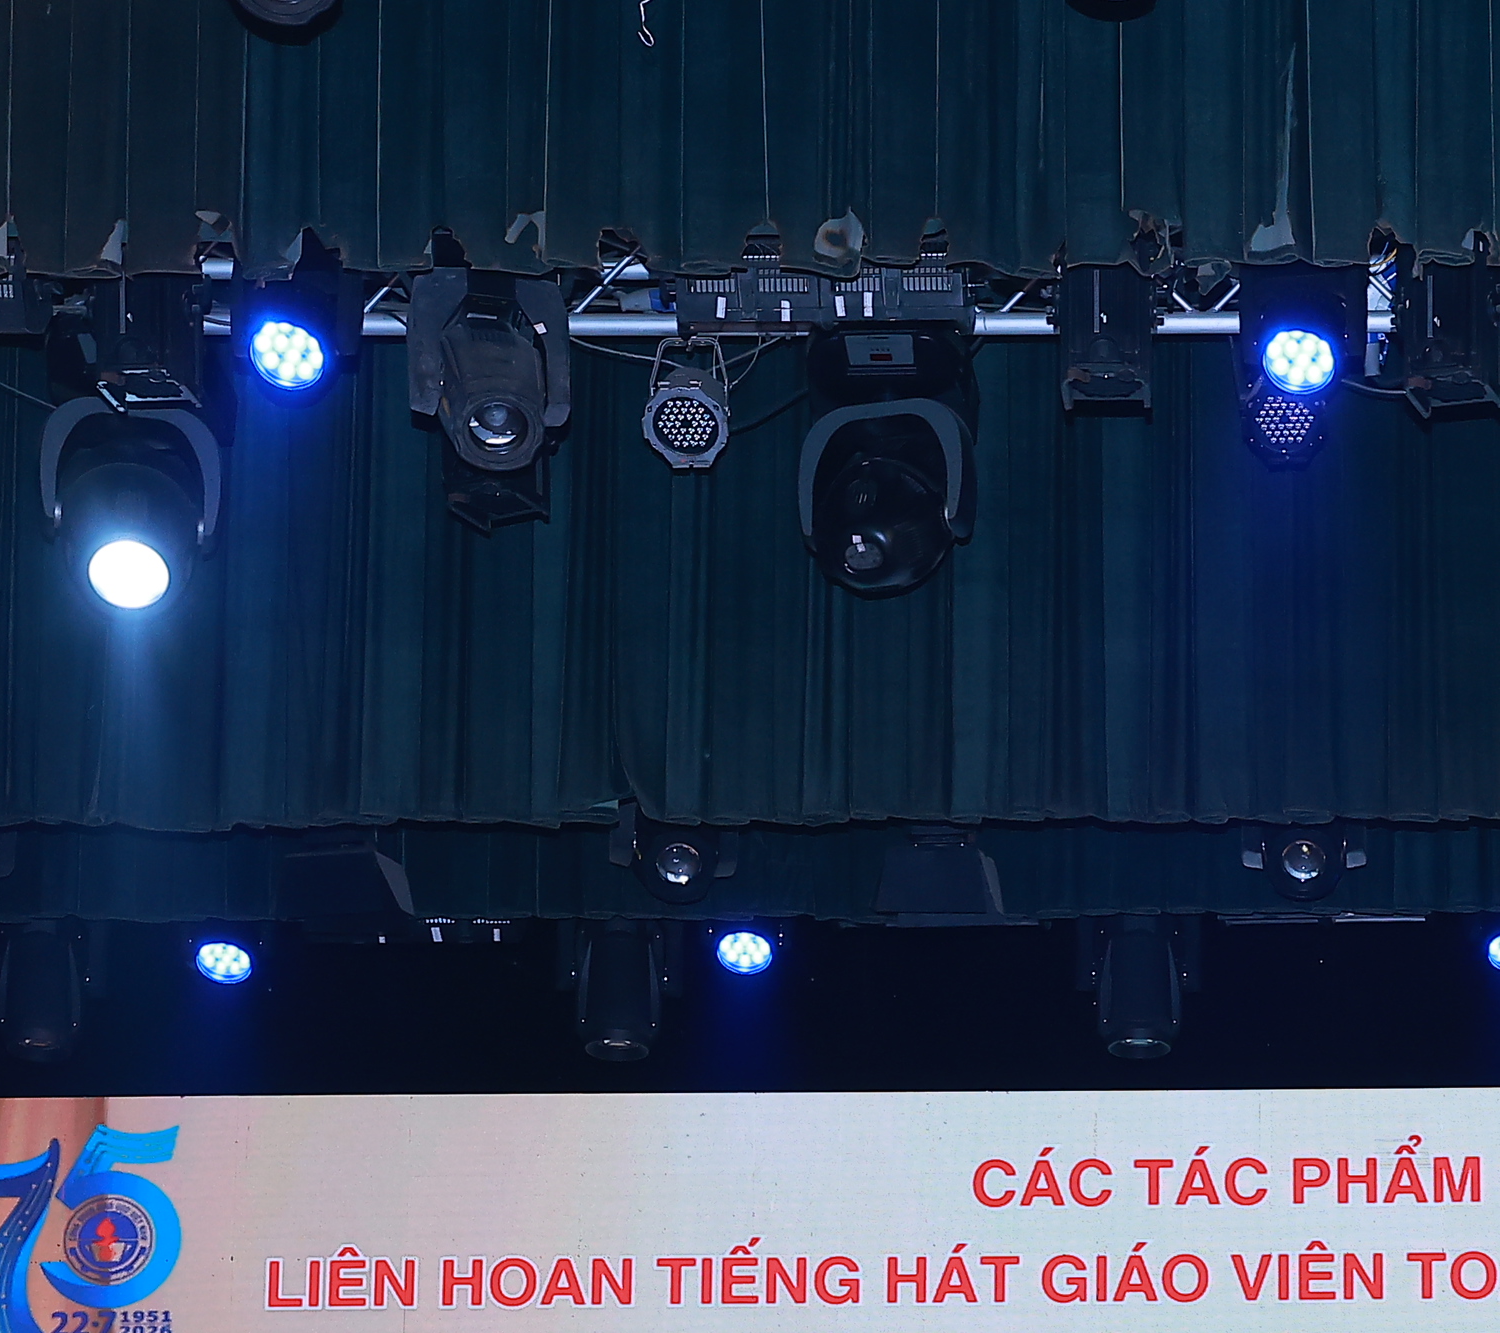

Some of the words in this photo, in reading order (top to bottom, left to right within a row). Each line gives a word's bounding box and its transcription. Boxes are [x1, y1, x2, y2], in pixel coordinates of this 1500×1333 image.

[973, 1146, 1113, 1208] CÁC
[1135, 1145, 1269, 1206] TÁC
[1293, 1134, 1482, 1205] PHẨM
[268, 1246, 416, 1308] LIÊN
[442, 1257, 633, 1307] HOAN
[656, 1236, 861, 1305] TIẾNG
[887, 1243, 1021, 1304] HÁT
[1041, 1241, 1210, 1304] GIÁO
[1231, 1240, 1384, 1301] VIÊN
[121, 1310, 172, 1323] 1951
